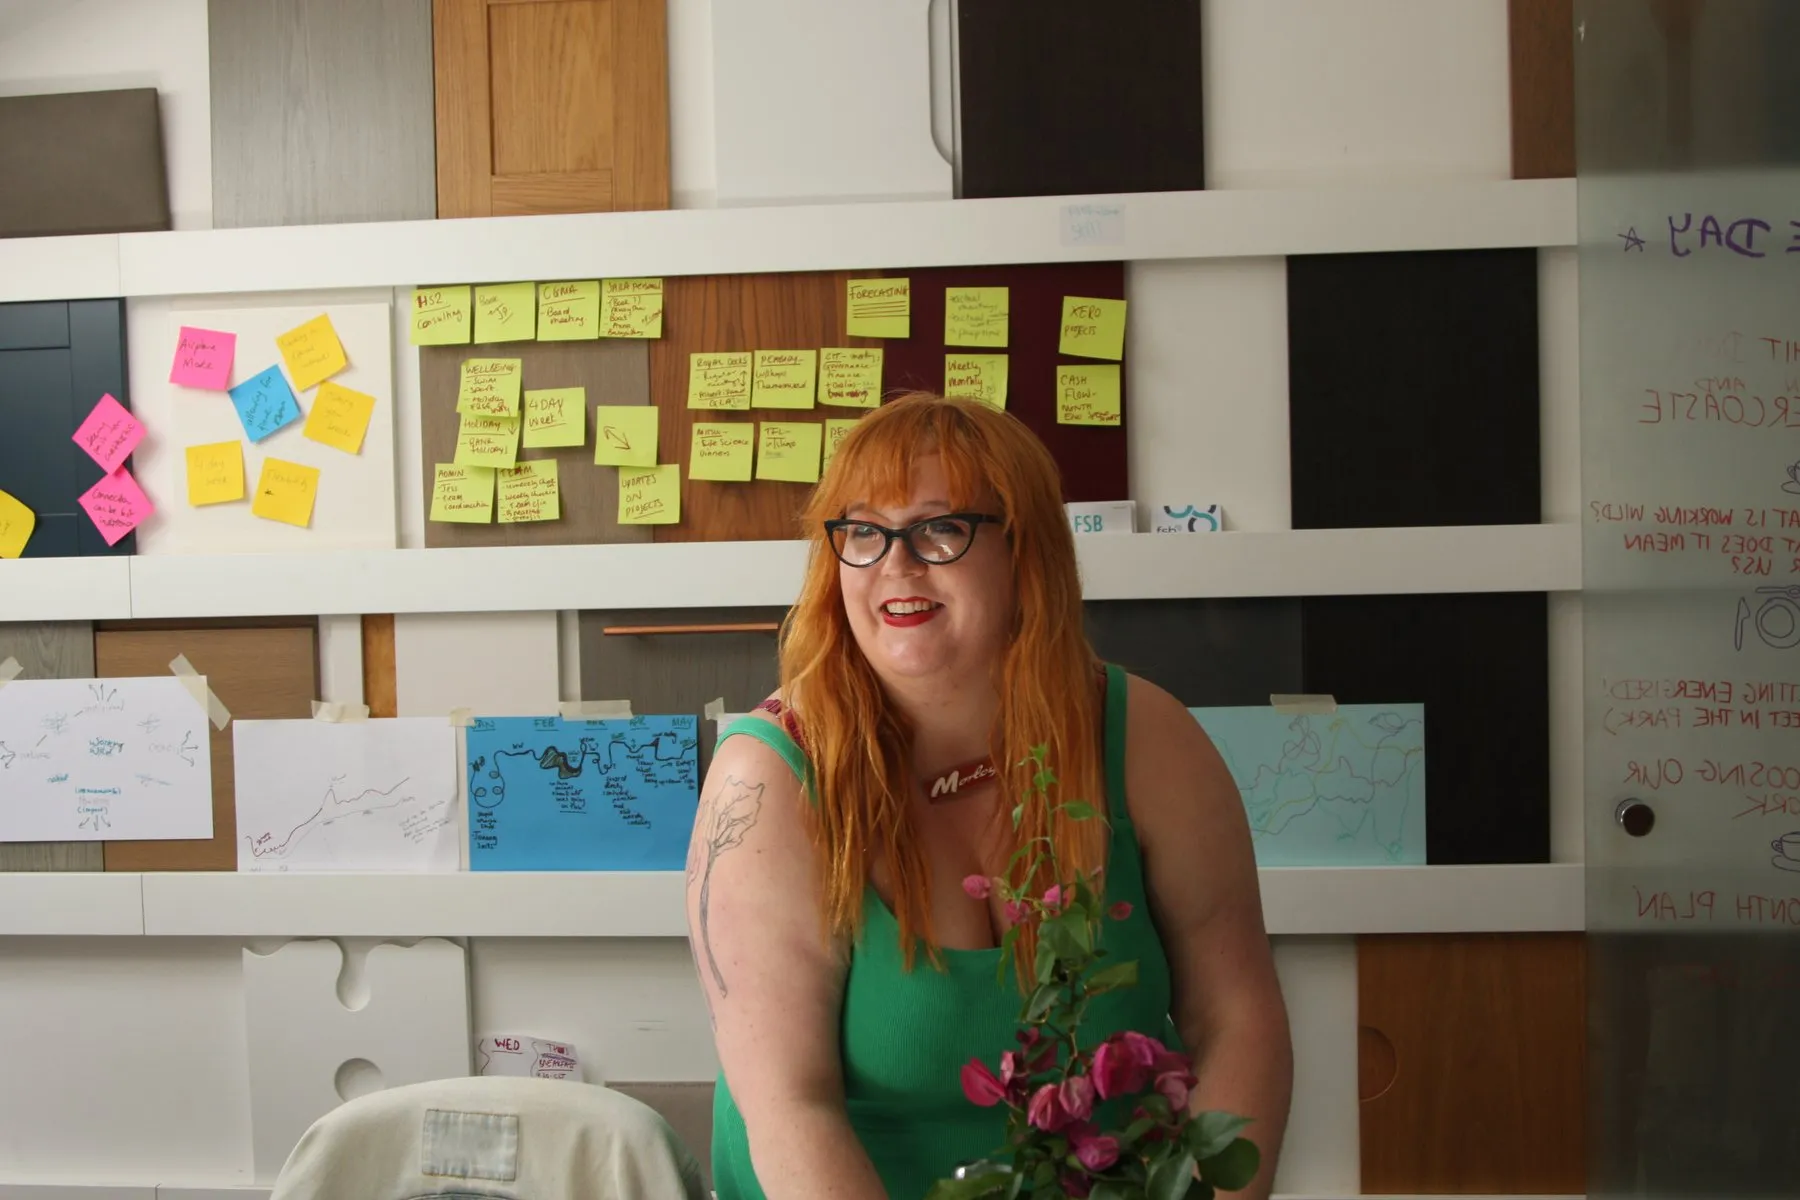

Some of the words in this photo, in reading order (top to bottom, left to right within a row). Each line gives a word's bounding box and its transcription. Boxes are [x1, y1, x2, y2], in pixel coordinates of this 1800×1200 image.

[849, 284, 909, 300] FORECASTING
[416, 292, 443, 308] HS2
[1060, 375, 1088, 386] CASH
[529, 399, 539, 408] 4
[621, 474, 657, 488] UPDATES
[1074, 514, 1103, 533] FSB
[494, 1038, 520, 1051] WED
